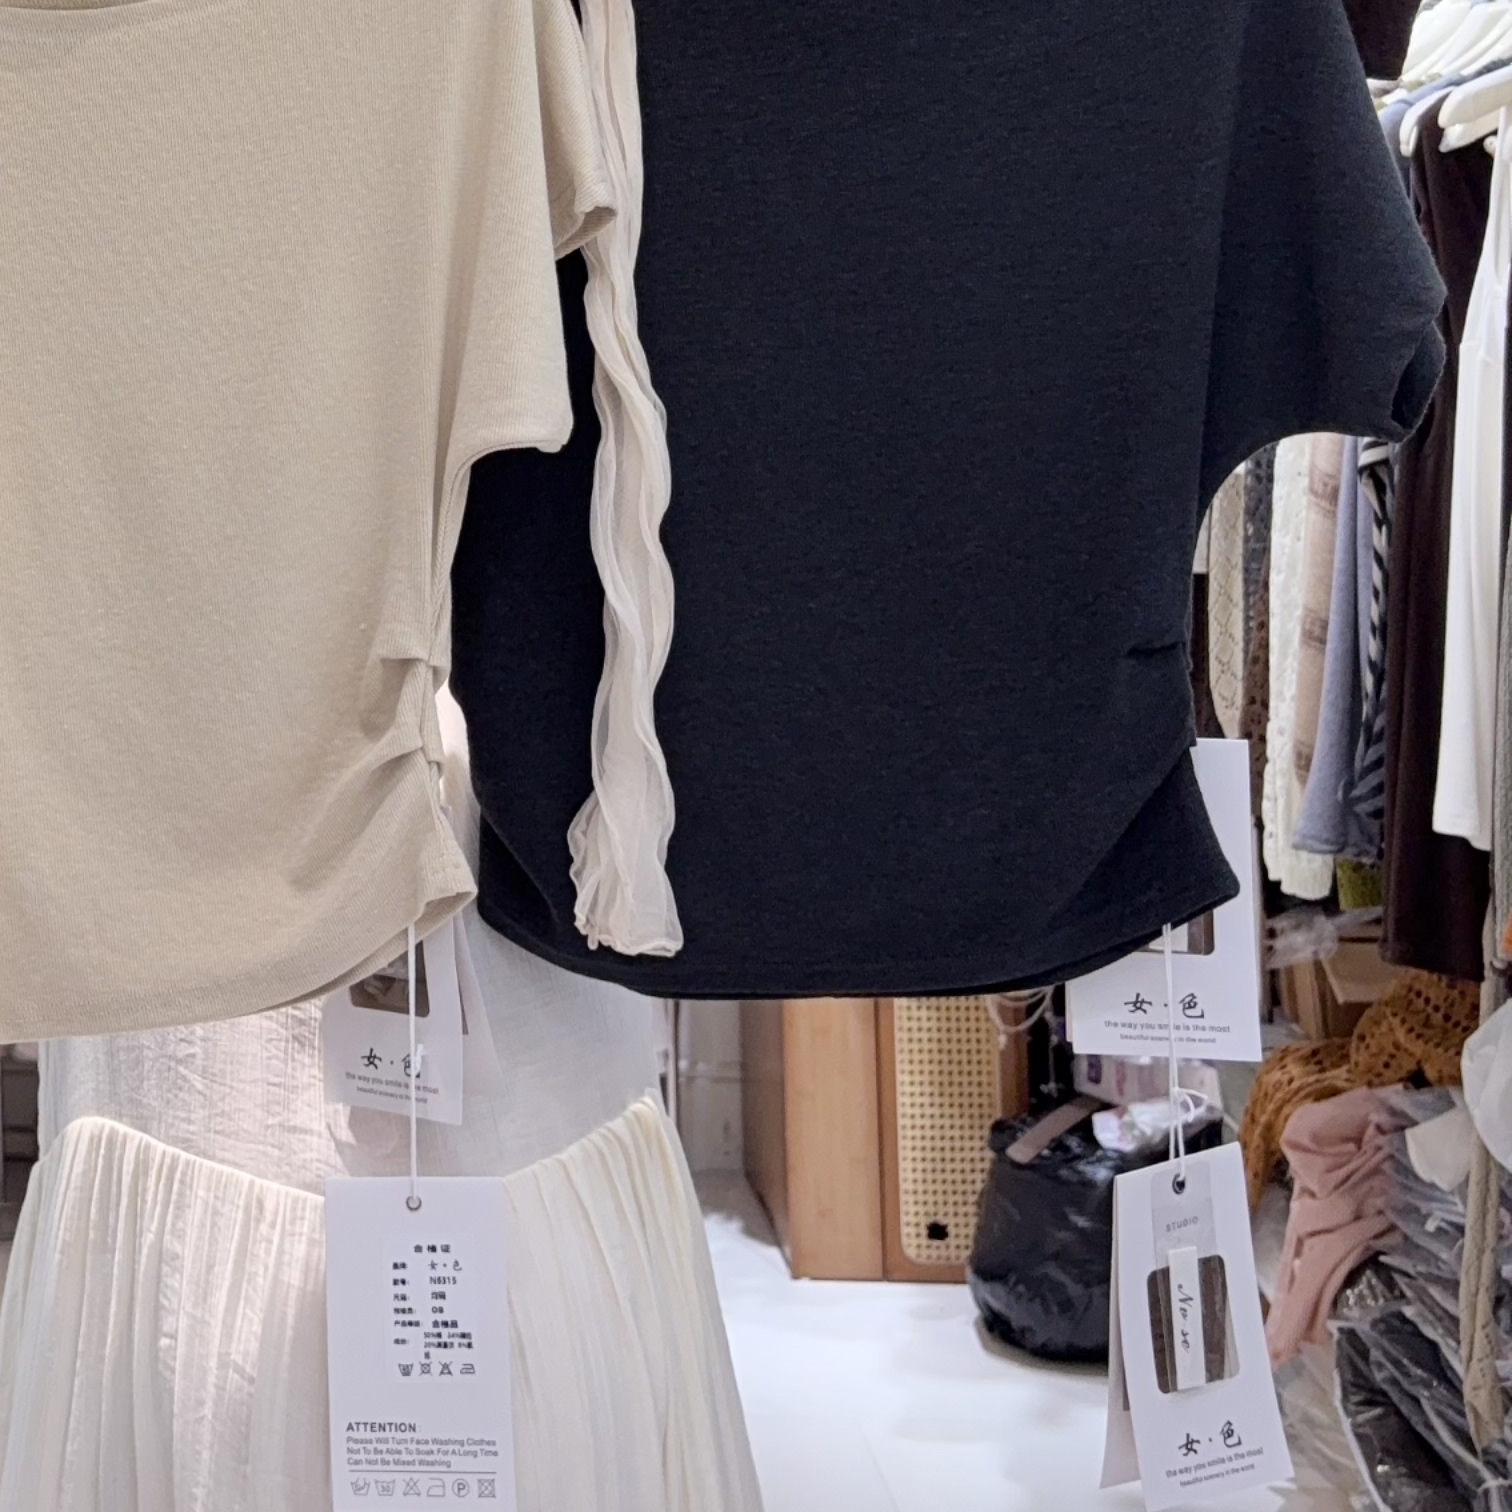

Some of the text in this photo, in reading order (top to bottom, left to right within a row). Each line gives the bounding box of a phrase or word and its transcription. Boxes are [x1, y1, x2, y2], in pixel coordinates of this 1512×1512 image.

[1124, 992, 1205, 1019] 女·色
[1104, 1020, 1118, 1028] the
[1120, 1021, 1137, 1030] way
[1140, 1022, 1156, 1031] you
[1157, 1023, 1181, 1031] smle
[1192, 1024, 1207, 1032] the
[1208, 1024, 1231, 1033] most
[1166, 1216, 1199, 1232] STUDIO
[346, 1436, 497, 1448] Please Will Turn Face Washing Clothes
[1178, 1420, 1242, 1457] 女·色
[346, 1446, 499, 1459] Not To Be Able To Soak For A Long Time
[347, 1457, 452, 1469] Can Not Be Mixed Washing
[1178, 1466, 1192, 1474] way
